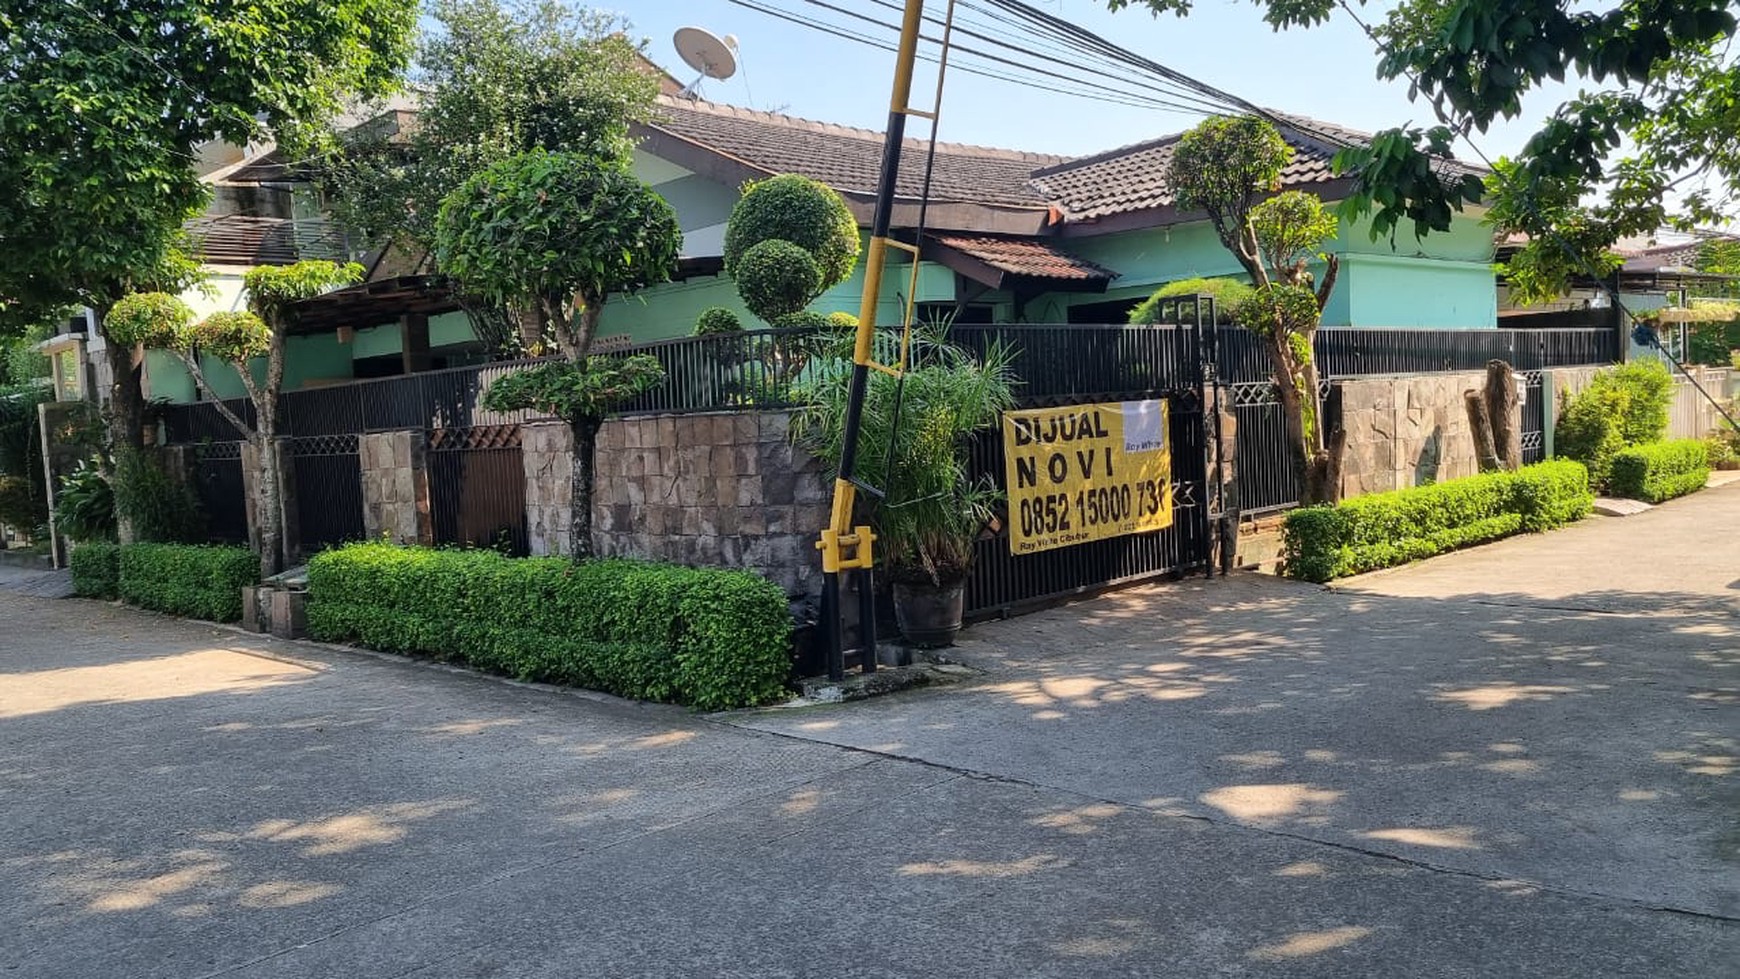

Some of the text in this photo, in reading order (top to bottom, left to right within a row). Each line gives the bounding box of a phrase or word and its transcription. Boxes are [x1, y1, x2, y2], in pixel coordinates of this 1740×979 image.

[1014, 411, 1108, 446] DIJUAL
[1020, 493, 1070, 537] 0852
[1076, 483, 1131, 527] 15000
[1020, 542, 1036, 551] Ray
